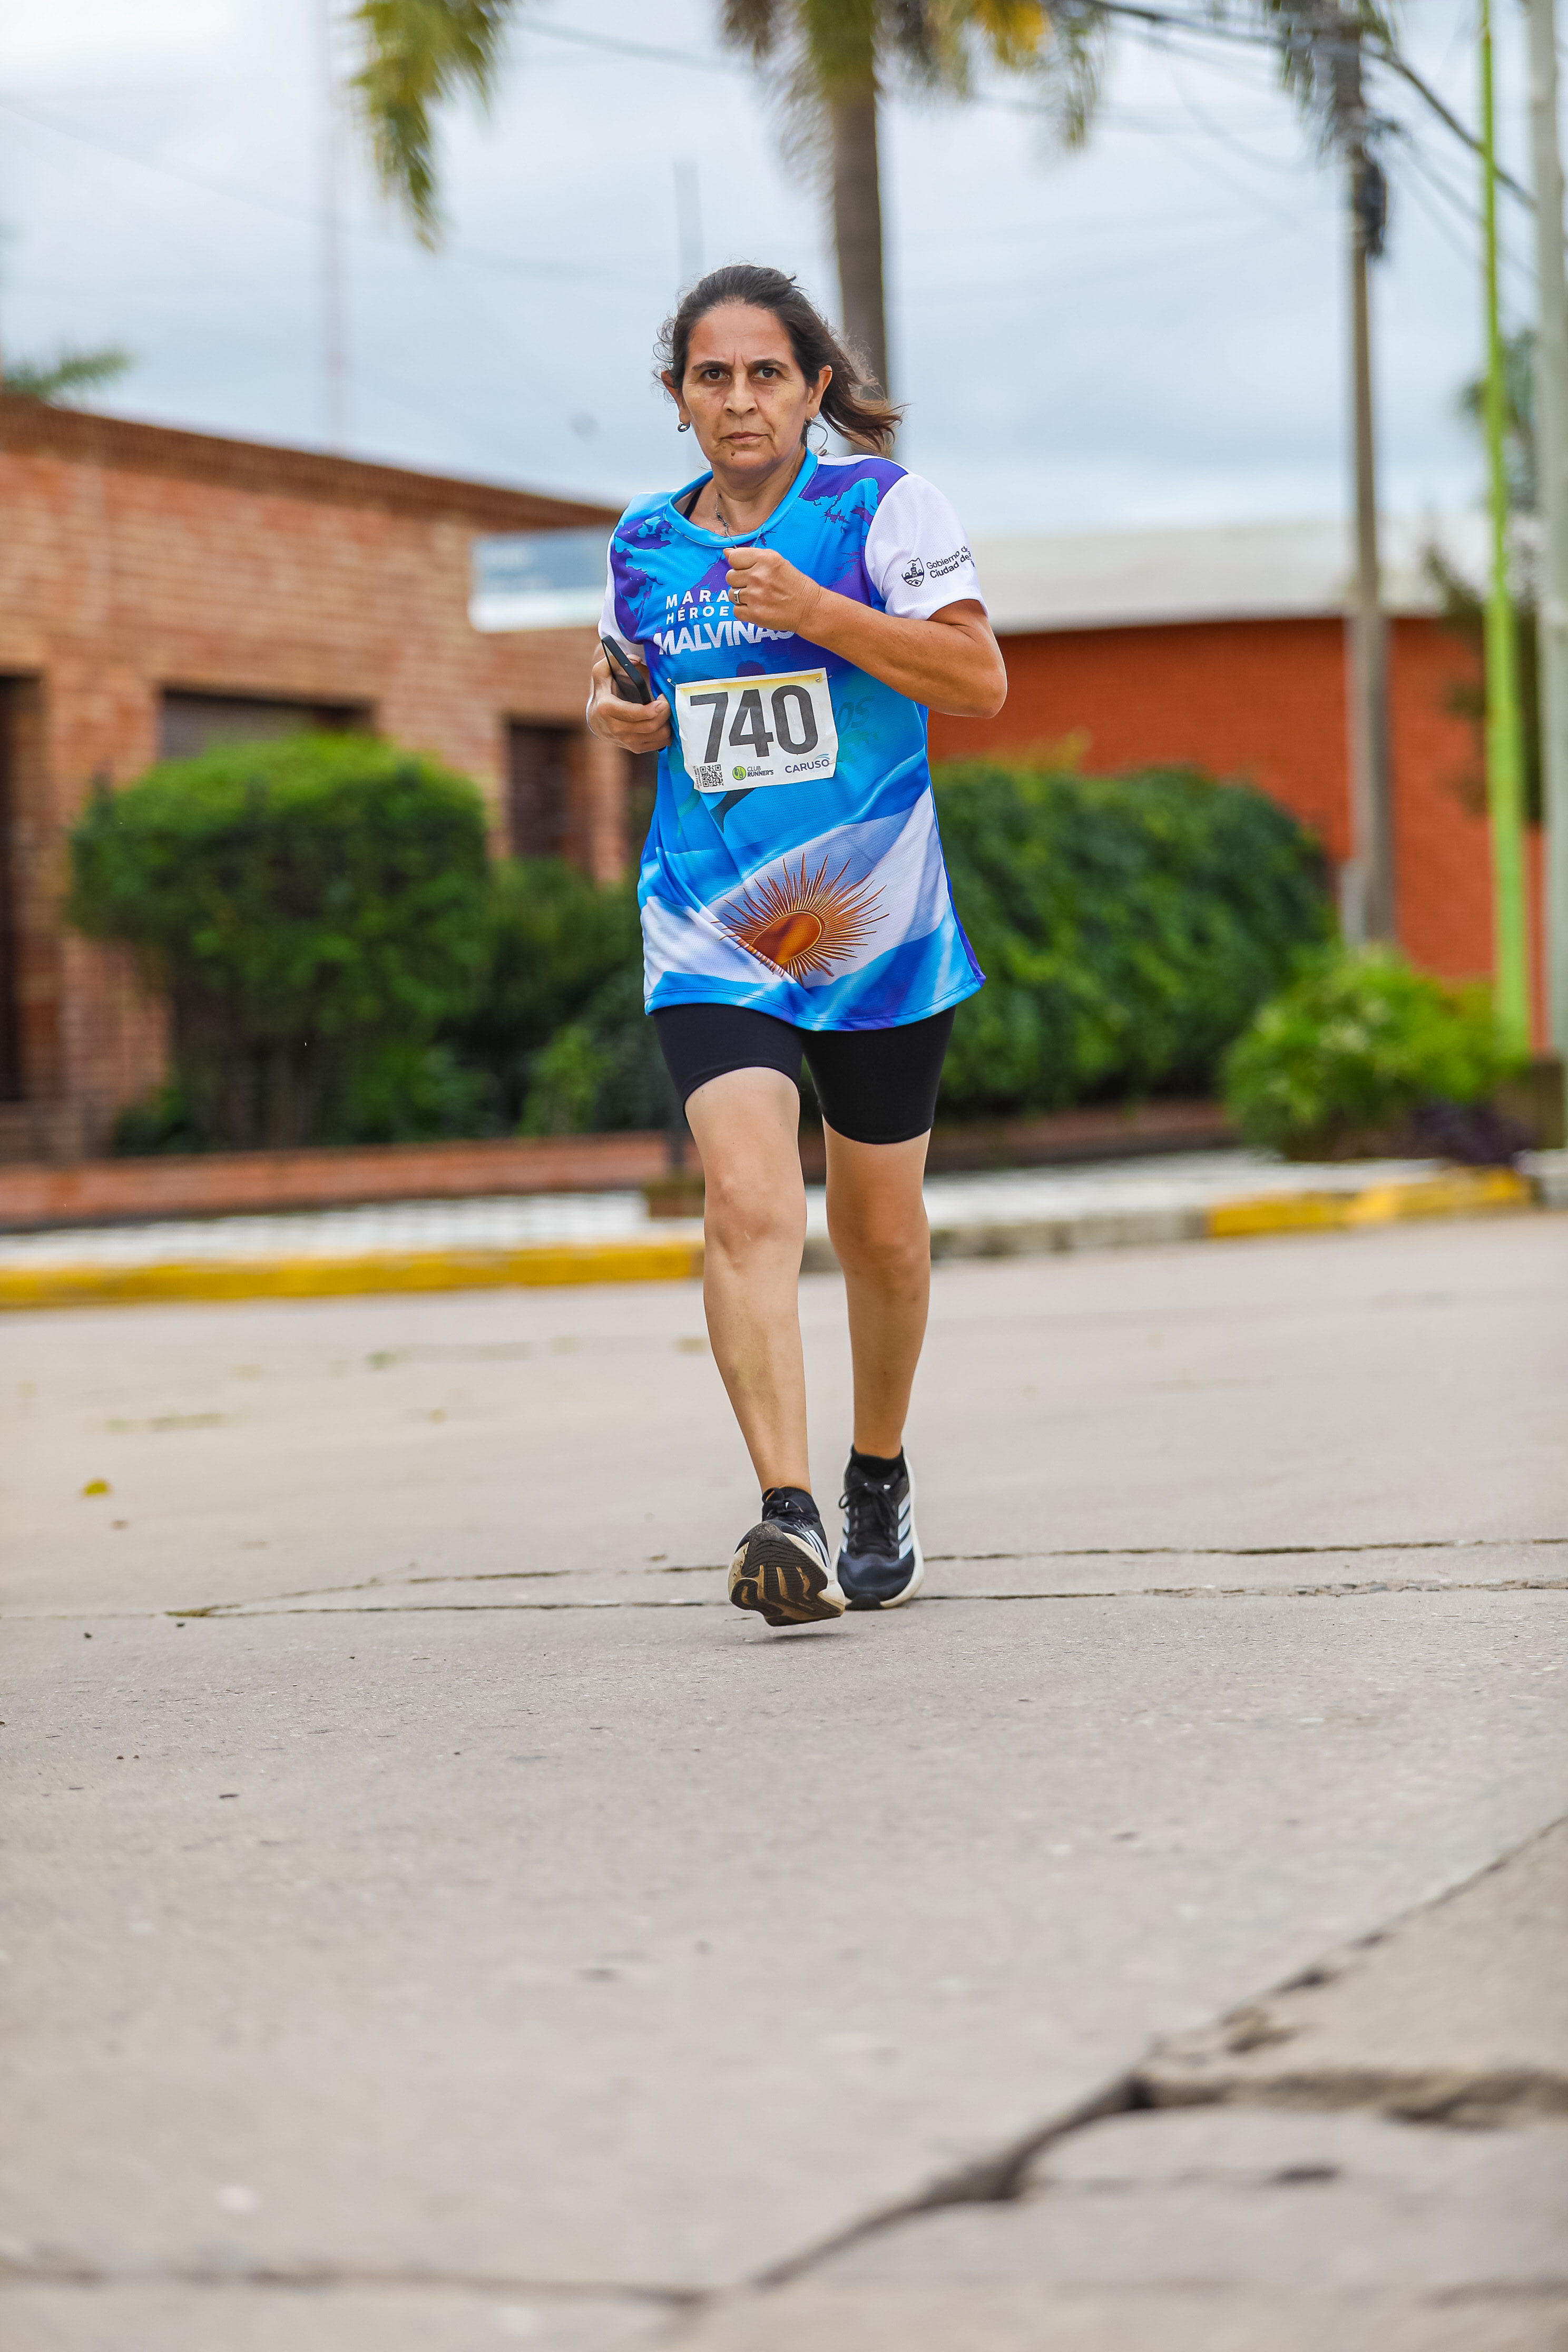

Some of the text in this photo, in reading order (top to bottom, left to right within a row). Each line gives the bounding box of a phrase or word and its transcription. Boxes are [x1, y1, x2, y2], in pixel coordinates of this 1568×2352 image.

[926, 551, 959, 570] Gobierno
[929, 561, 959, 578] Ciudad
[960, 554, 970, 563] de
[665, 590, 729, 610] MARA
[666, 606, 729, 625] HÉROE
[690, 685, 818, 763] 740
[785, 759, 830, 773] CARUSO
